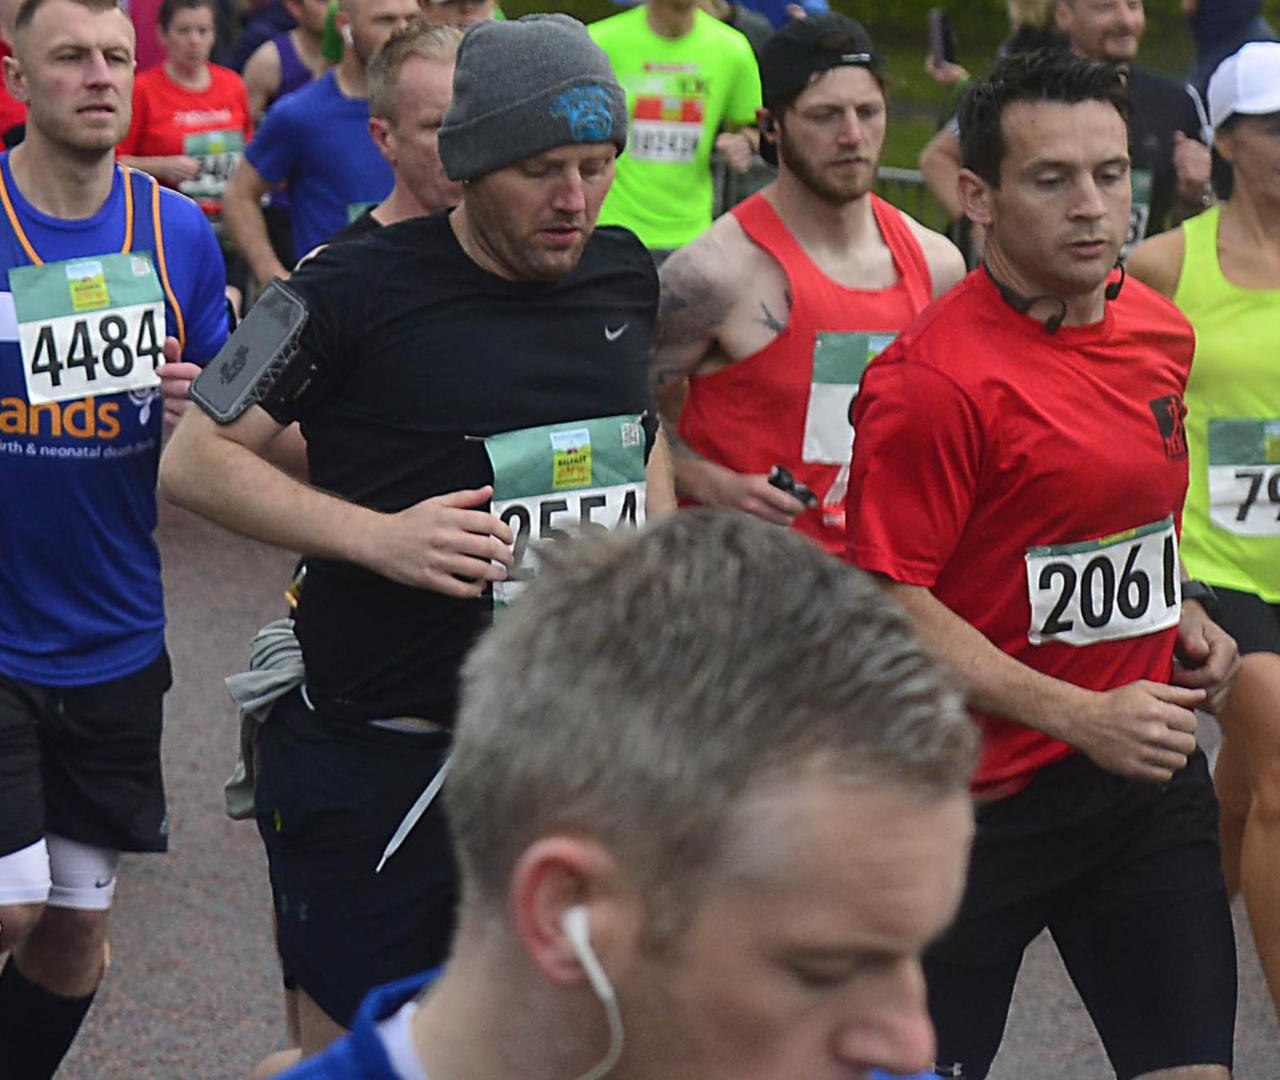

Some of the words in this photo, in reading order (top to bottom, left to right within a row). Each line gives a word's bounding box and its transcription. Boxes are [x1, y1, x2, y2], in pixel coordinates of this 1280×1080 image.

[31, 309, 164, 387] 4484
[26, 443, 37, 456] &
[40, 444, 101, 458] neonatal
[1039, 536, 1177, 635] 2061
